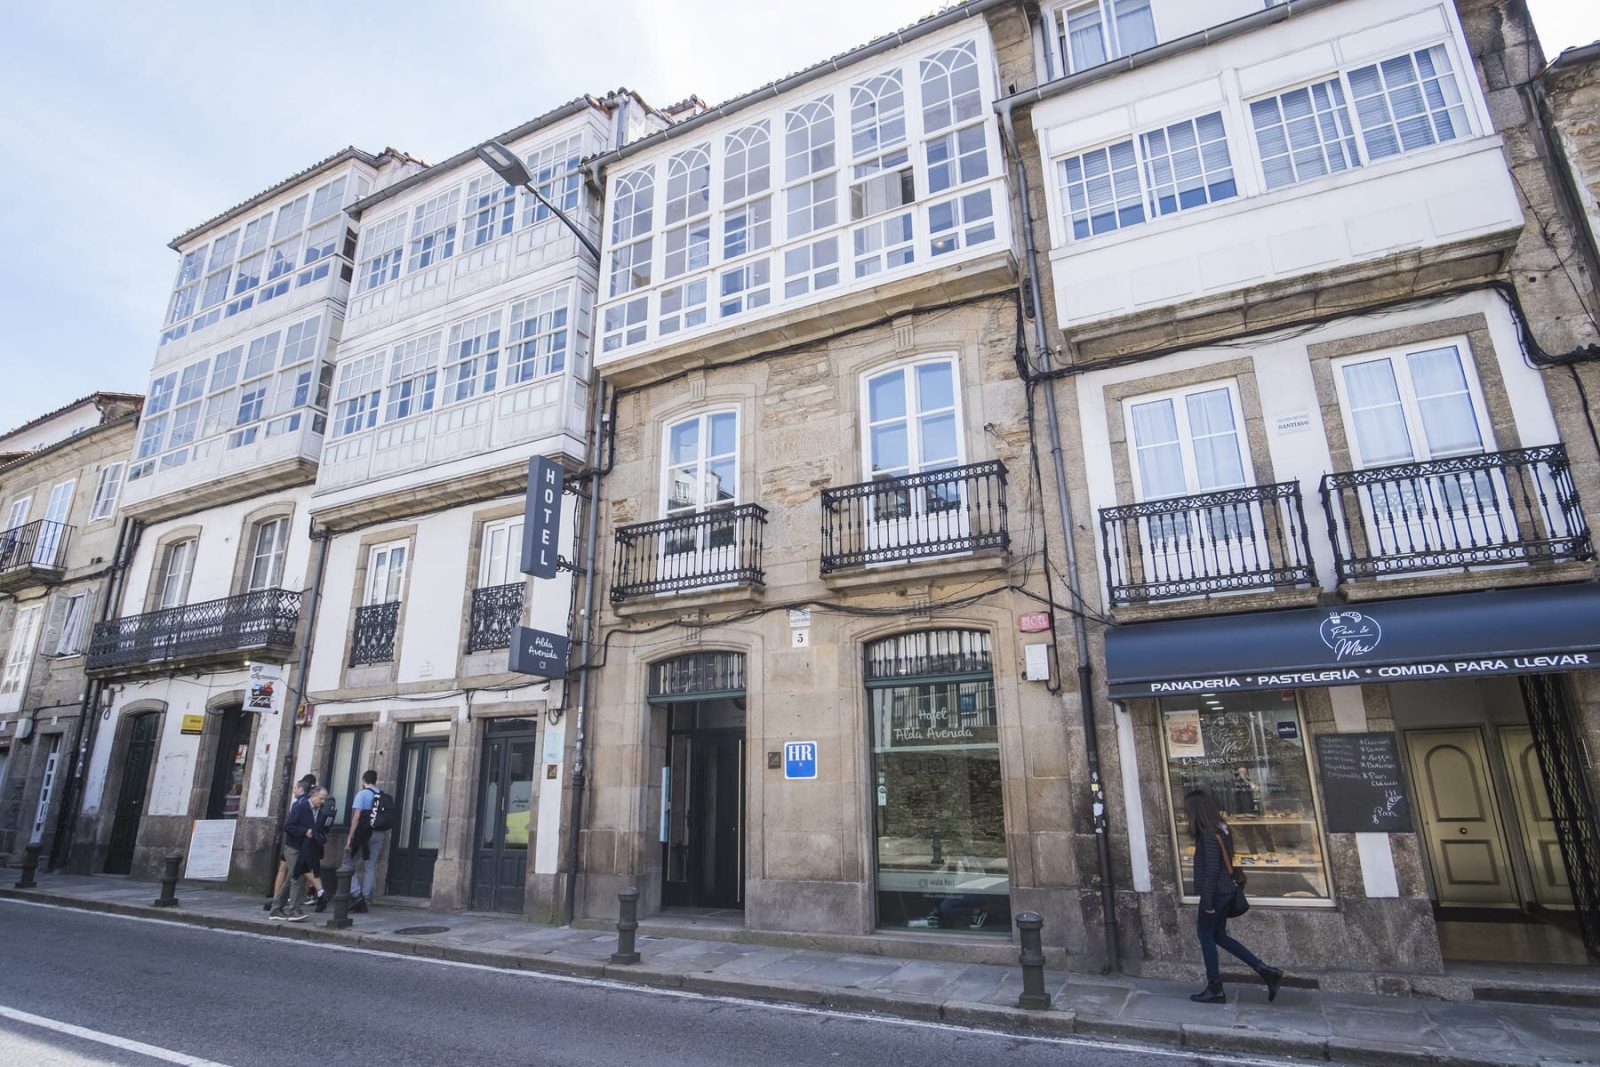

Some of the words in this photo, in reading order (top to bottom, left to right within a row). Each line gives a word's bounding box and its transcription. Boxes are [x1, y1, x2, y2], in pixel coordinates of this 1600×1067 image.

[539, 468, 556, 566] HOTEL
[797, 633, 804, 644] 5
[1330, 625, 1356, 640] Pan
[1359, 624, 1370, 634] &
[534, 636, 554, 650] Alda
[528, 646, 559, 661] Avenida
[1150, 675, 1240, 693] PANADERÍA
[1257, 667, 1359, 687] PASTELERÍA
[1378, 662, 1448, 678] COMIDA
[1454, 658, 1507, 673] PARA
[1513, 652, 1590, 668] LLEVAR
[917, 706, 949, 721] Hotel
[894, 726, 922, 741] Alda
[926, 727, 974, 741] Avenida
[788, 744, 813, 761] HR
[1374, 806, 1399, 818] Pan
